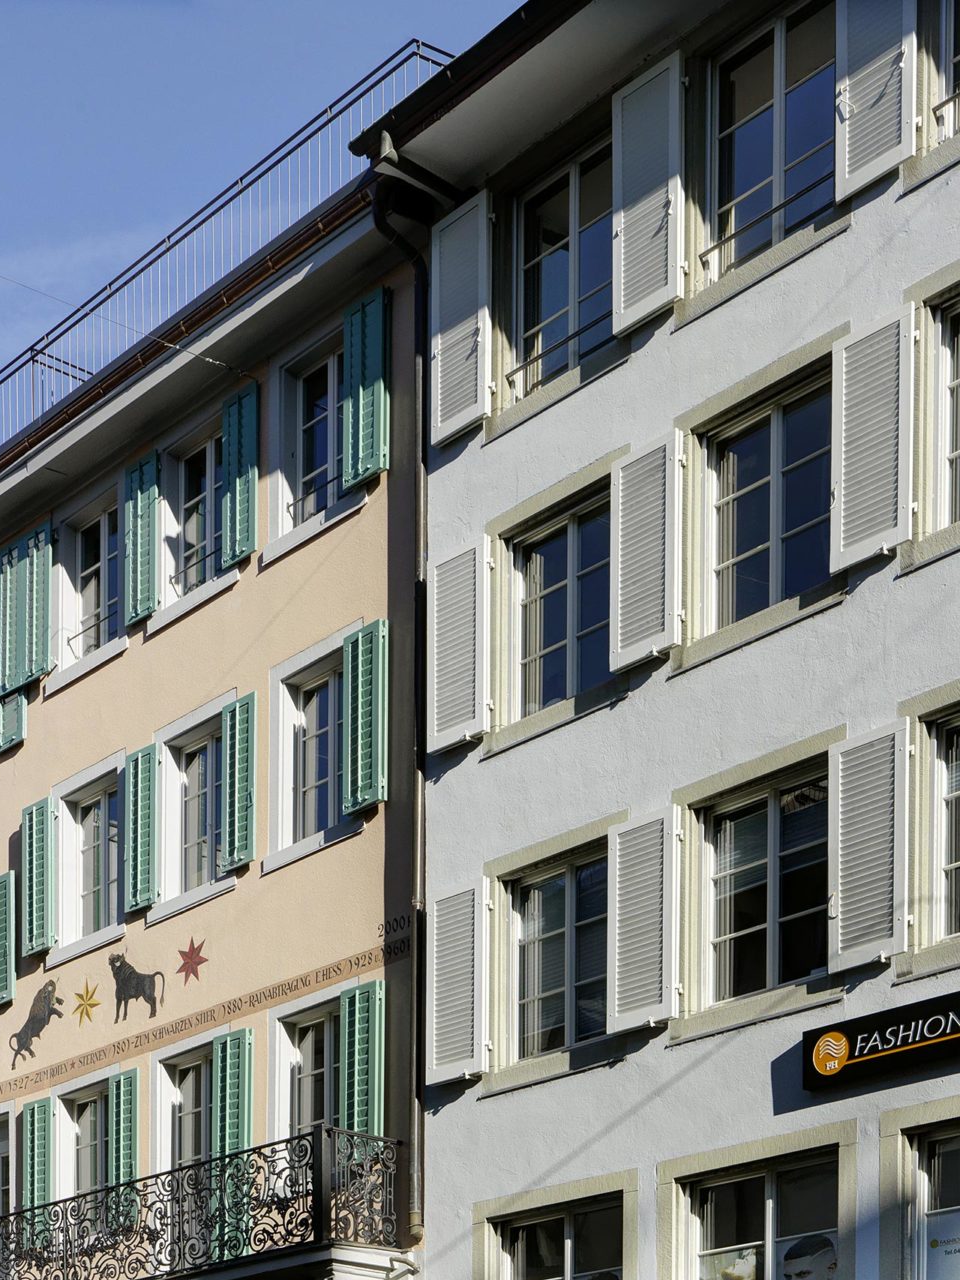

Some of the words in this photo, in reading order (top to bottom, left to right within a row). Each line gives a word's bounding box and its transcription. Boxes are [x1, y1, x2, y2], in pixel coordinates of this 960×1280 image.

[78, 1049, 107, 1068] STERNEN
[152, 1016, 193, 1040] SCHWARZEN
[195, 1008, 217, 1025] STIER
[348, 952, 373, 974] 1928
[854, 1011, 960, 1057] FASHION
